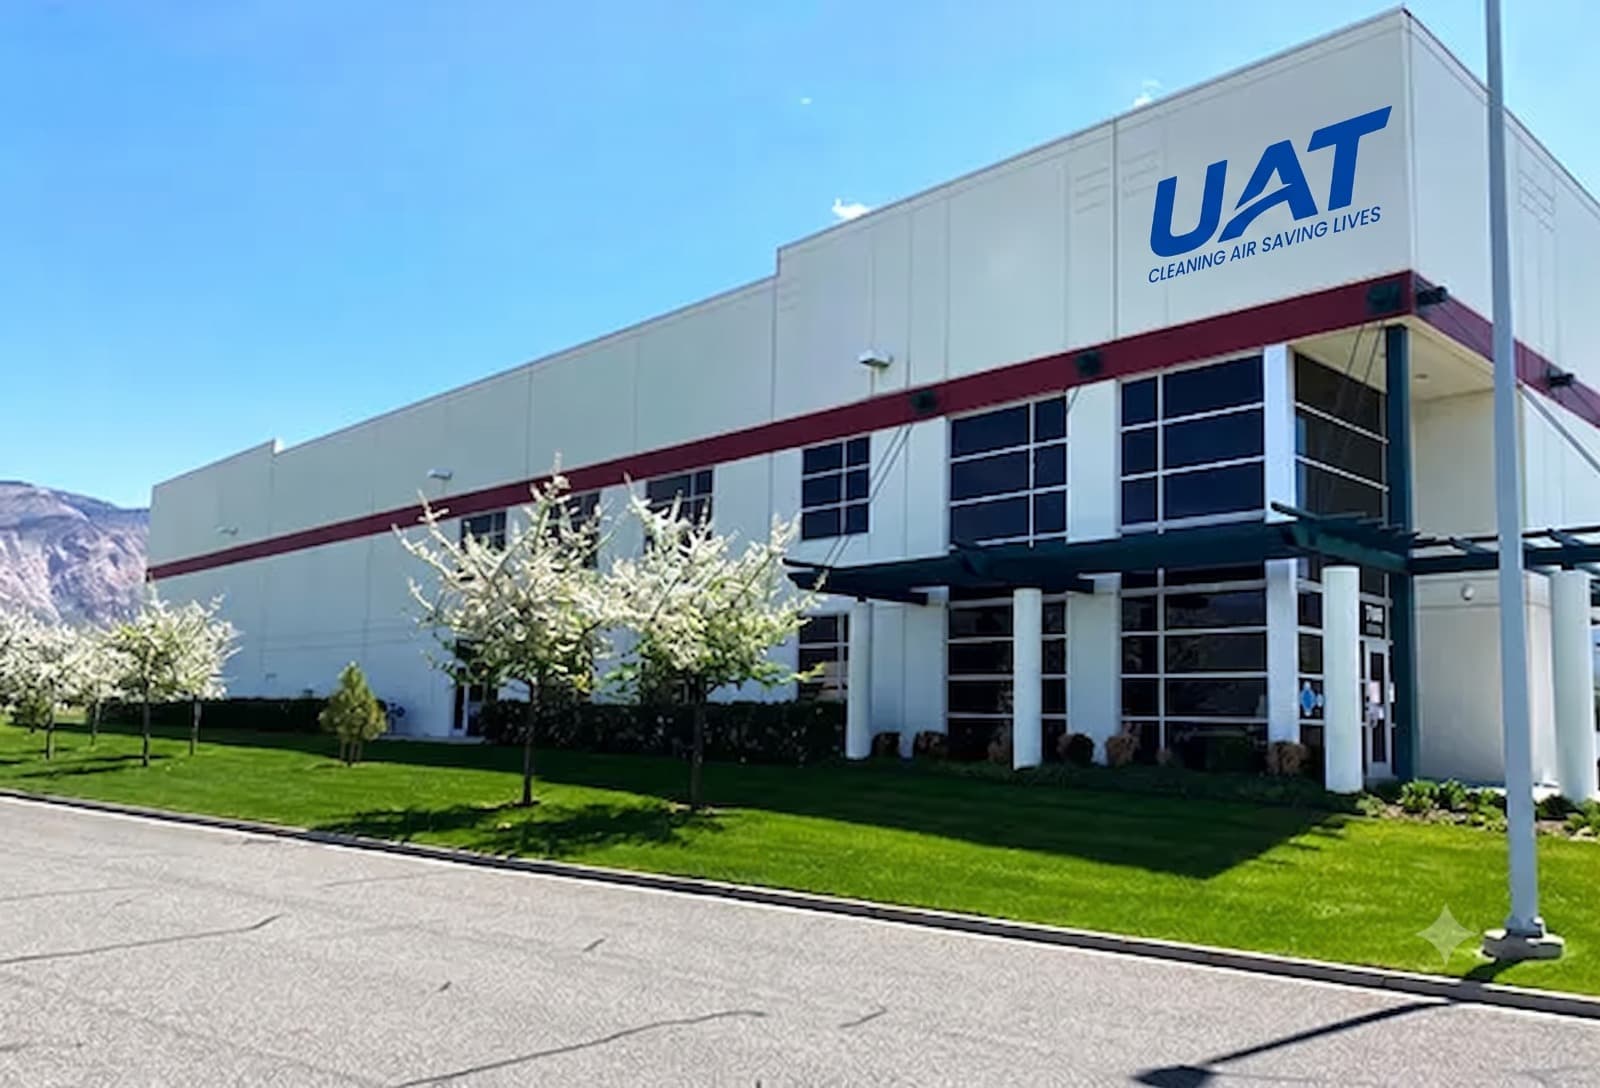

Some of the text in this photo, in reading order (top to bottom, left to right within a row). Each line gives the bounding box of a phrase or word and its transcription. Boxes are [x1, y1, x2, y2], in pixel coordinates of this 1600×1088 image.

[1150, 105, 1392, 257] UAT
[1148, 206, 1381, 283] CLEANING AIR SAVING LIVES
